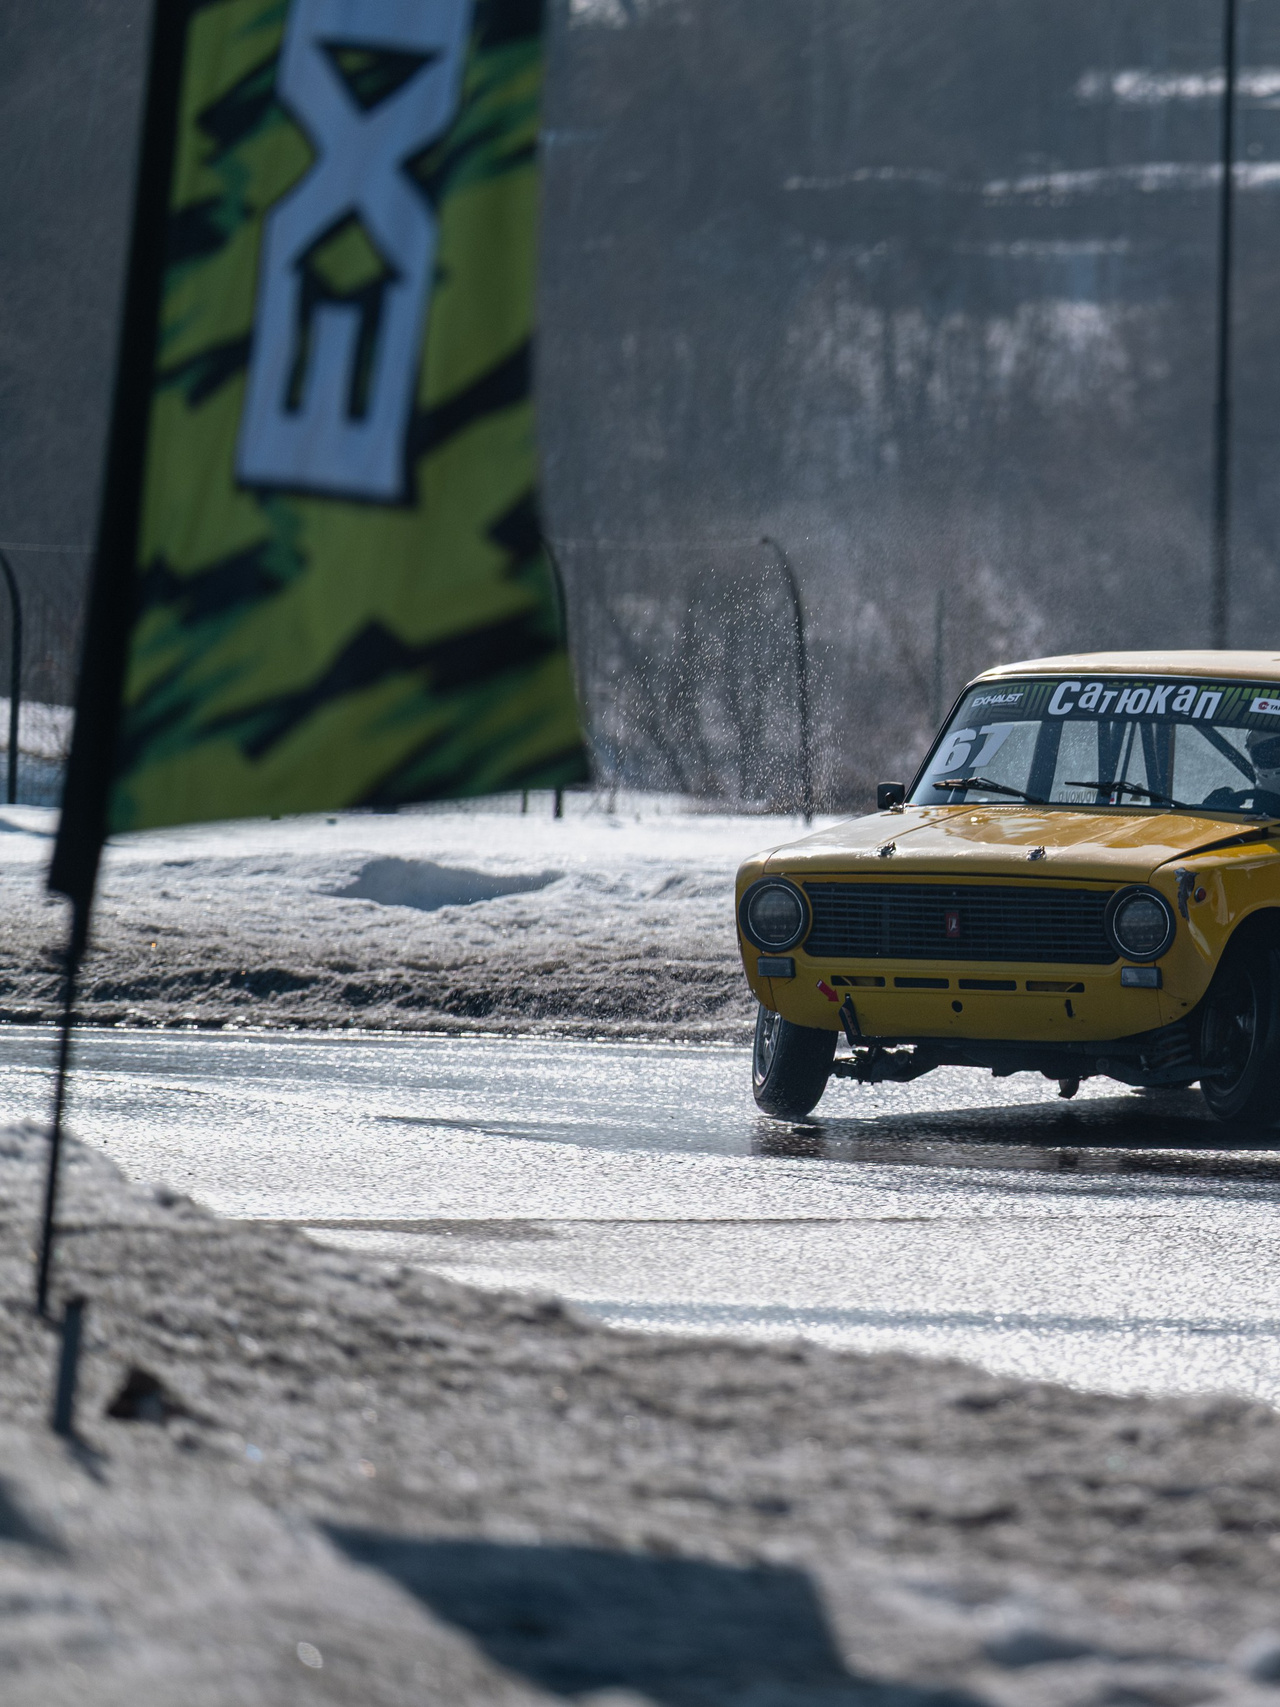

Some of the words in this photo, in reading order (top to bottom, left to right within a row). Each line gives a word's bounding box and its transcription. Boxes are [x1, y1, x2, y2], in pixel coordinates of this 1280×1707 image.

[238, 0, 476, 501] EX
[971, 692, 1024, 708] EXHAUST
[932, 724, 1015, 776] 67
